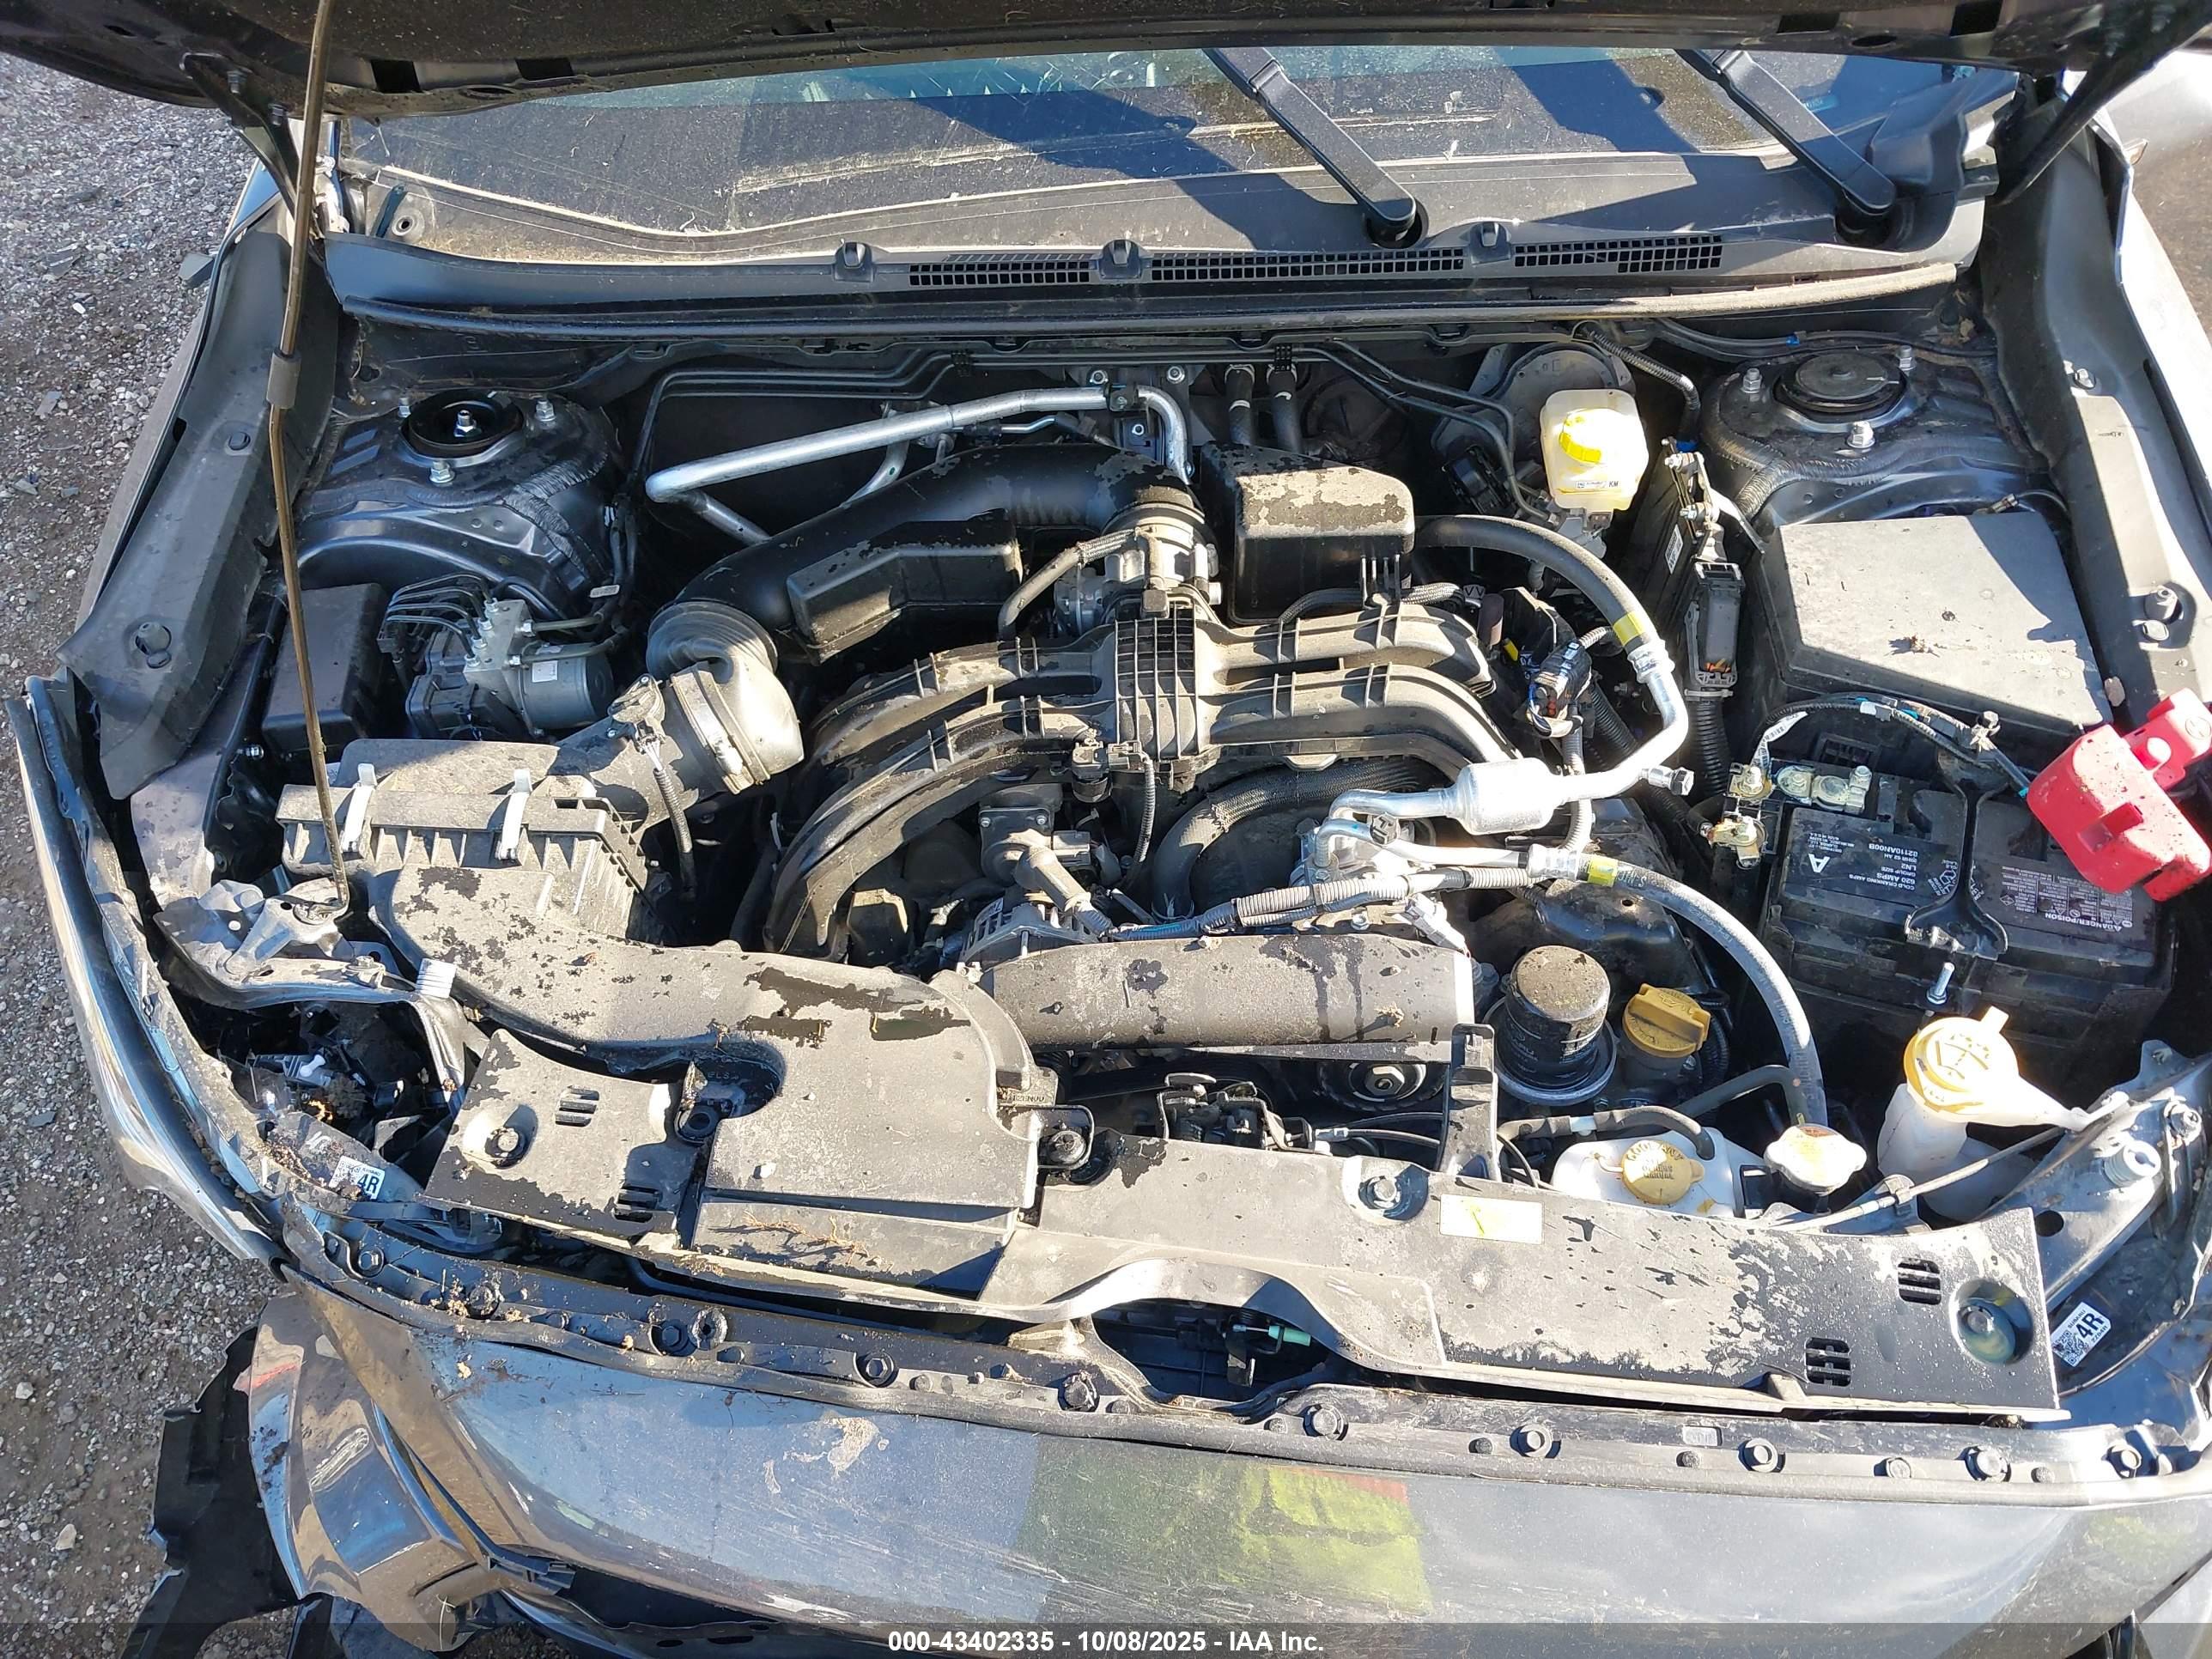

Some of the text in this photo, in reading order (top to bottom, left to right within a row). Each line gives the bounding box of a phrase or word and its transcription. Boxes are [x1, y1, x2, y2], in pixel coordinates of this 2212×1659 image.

[1808, 854, 1830, 873] A
[1866, 878, 1898, 888] CRANKING
[1876, 872, 1899, 881] AMPS
[2045, 912, 2117, 930] DANGER/POISON
[357, 1173, 380, 1194] 4R
[2067, 1309, 2087, 1328] SUBARU
[2075, 1313, 2105, 1339] 4R
